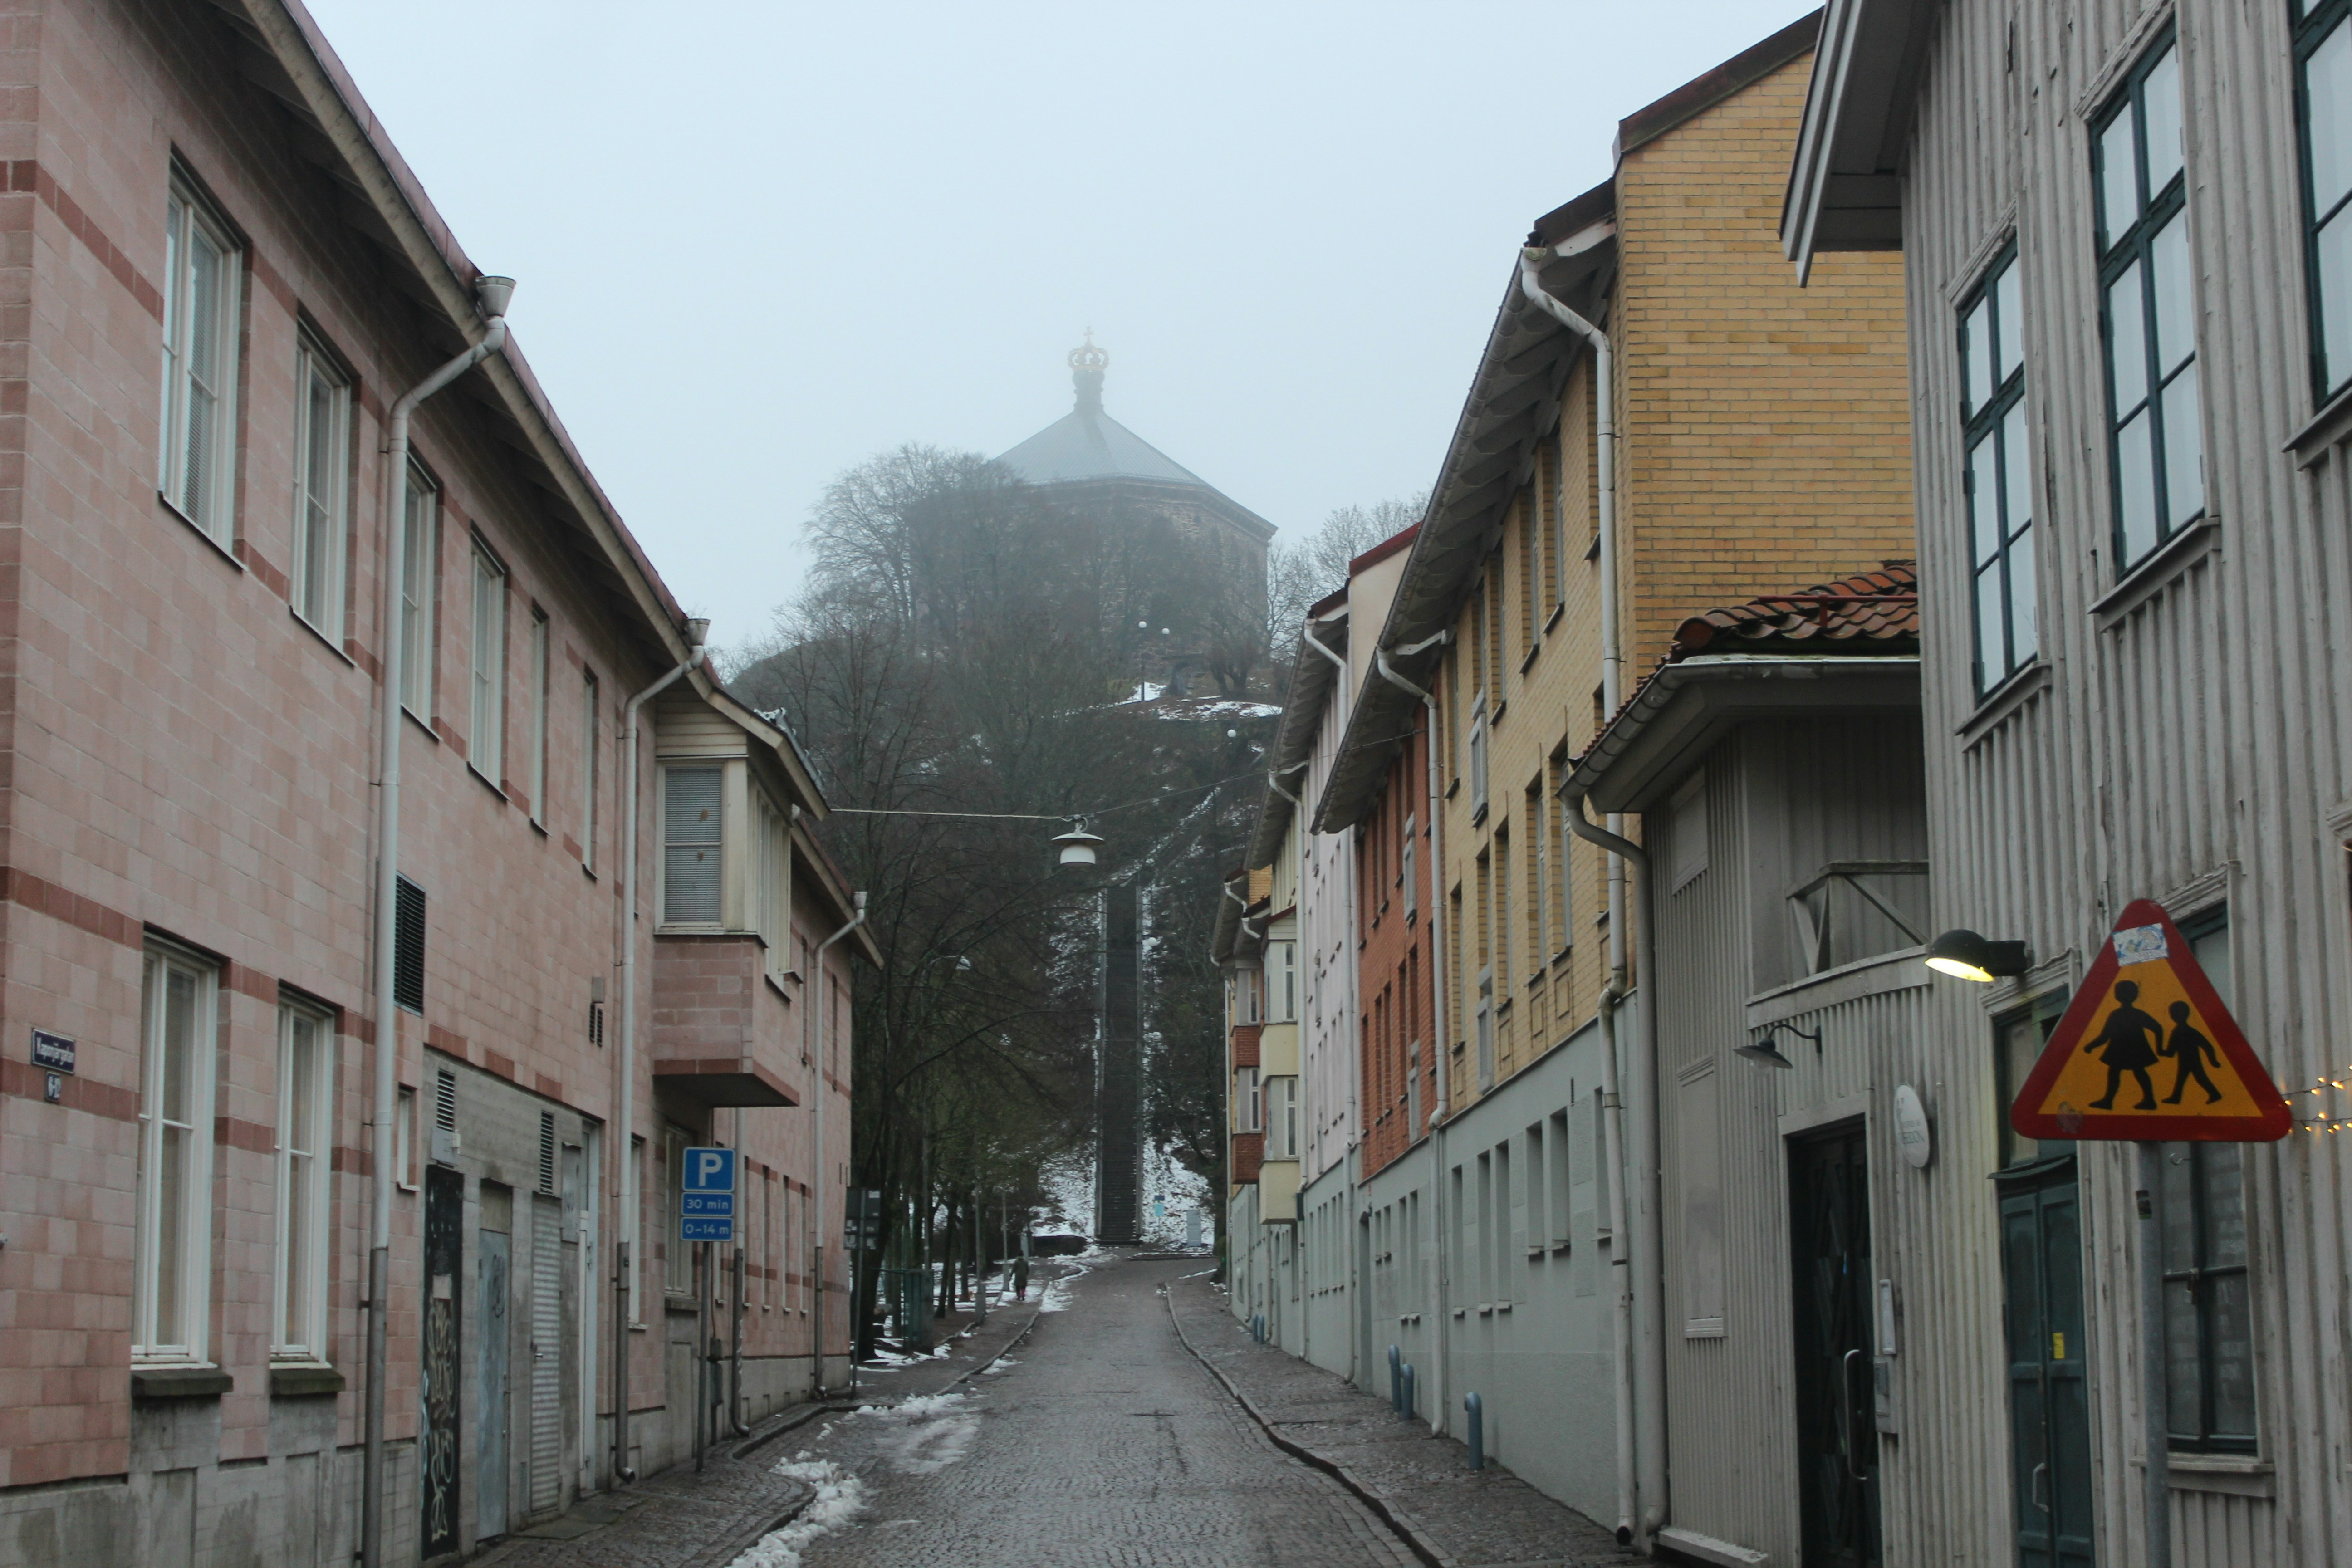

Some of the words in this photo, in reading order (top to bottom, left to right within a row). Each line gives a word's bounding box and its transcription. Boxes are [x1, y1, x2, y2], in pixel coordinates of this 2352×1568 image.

[699, 1153, 723, 1186] P
[686, 1199, 702, 1209] 30
[707, 1200, 728, 1210] min
[685, 1224, 715, 1234] 0-14
